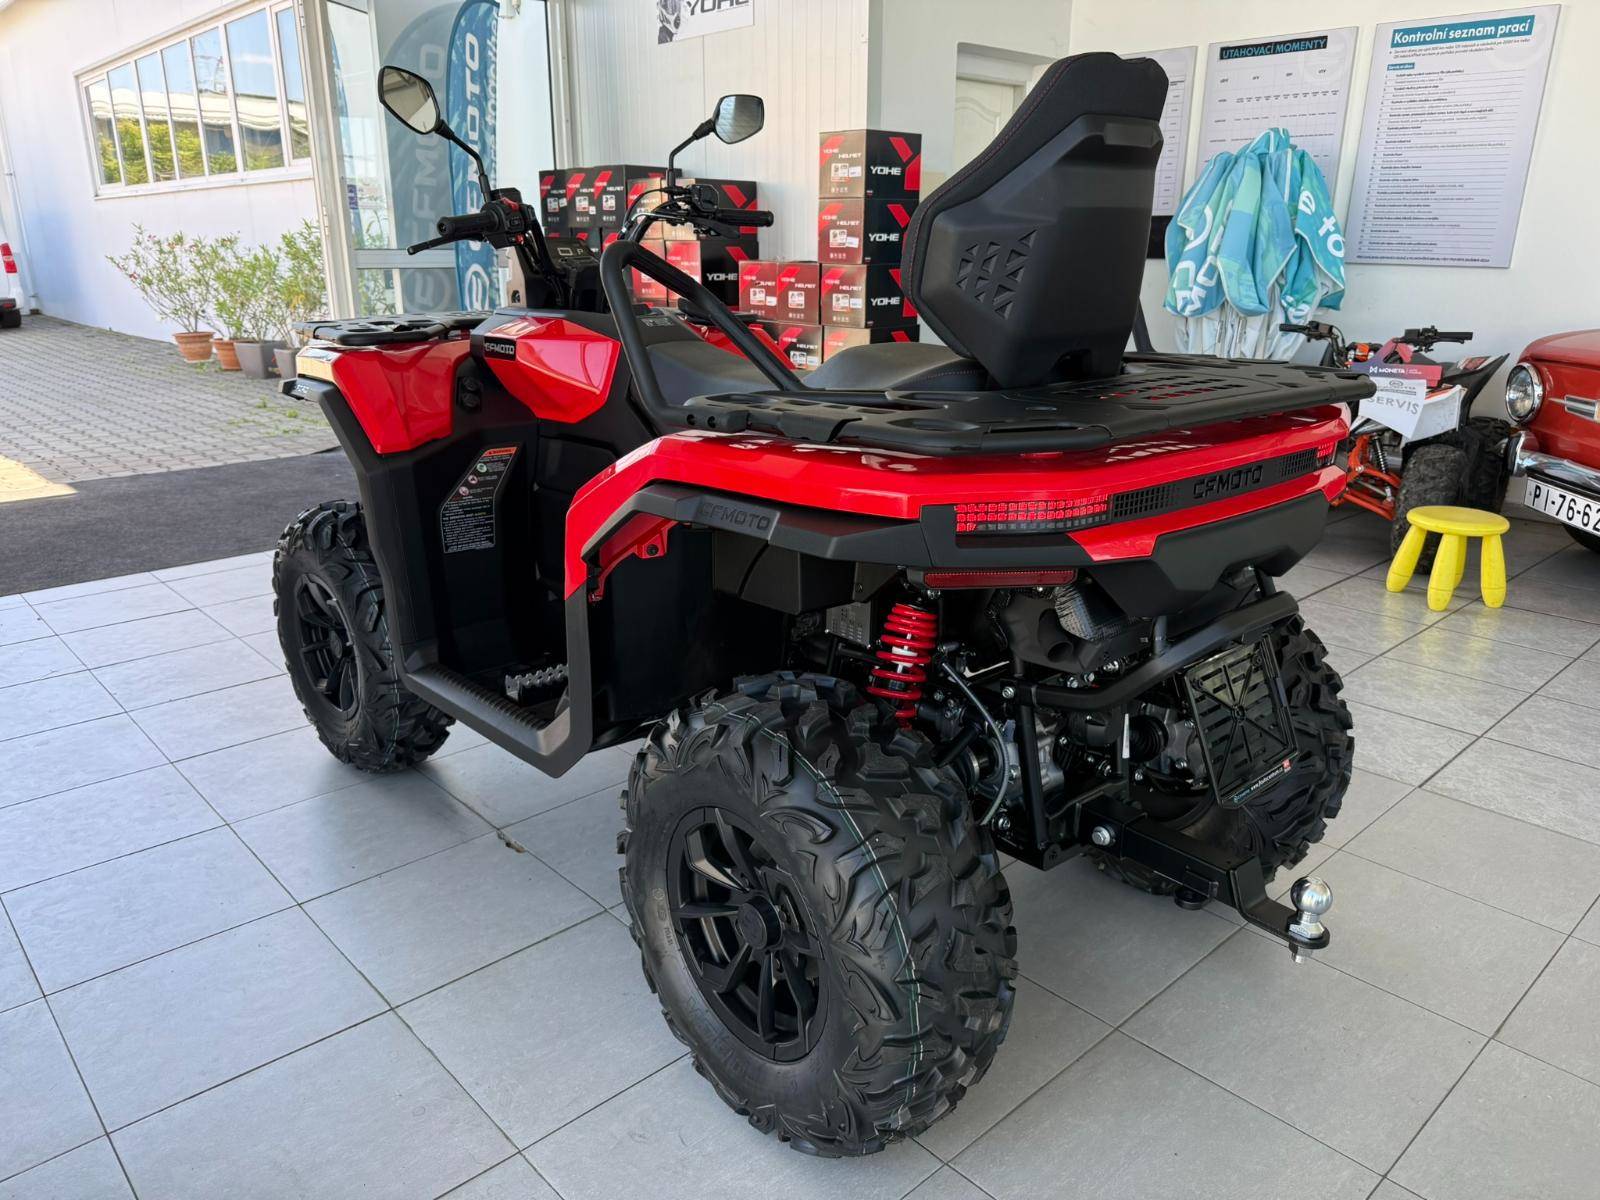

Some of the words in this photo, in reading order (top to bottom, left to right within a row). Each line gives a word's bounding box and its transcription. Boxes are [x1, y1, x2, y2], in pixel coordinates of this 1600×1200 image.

[686, 0, 749, 16] YOH
[1393, 25, 1447, 44] Kontrolní
[1449, 26, 1496, 39] seznam
[1497, 20, 1531, 38] prací
[1222, 43, 1275, 59] UTAHOVACÍ
[1275, 39, 1327, 53] MOMENTY
[870, 166, 902, 176] YOHE
[868, 233, 900, 242] YOHE
[706, 272, 738, 281] YOHE
[870, 296, 901, 306] YOHE
[1193, 465, 1263, 499] CFMOTO
[702, 502, 770, 531] CFMOTO
